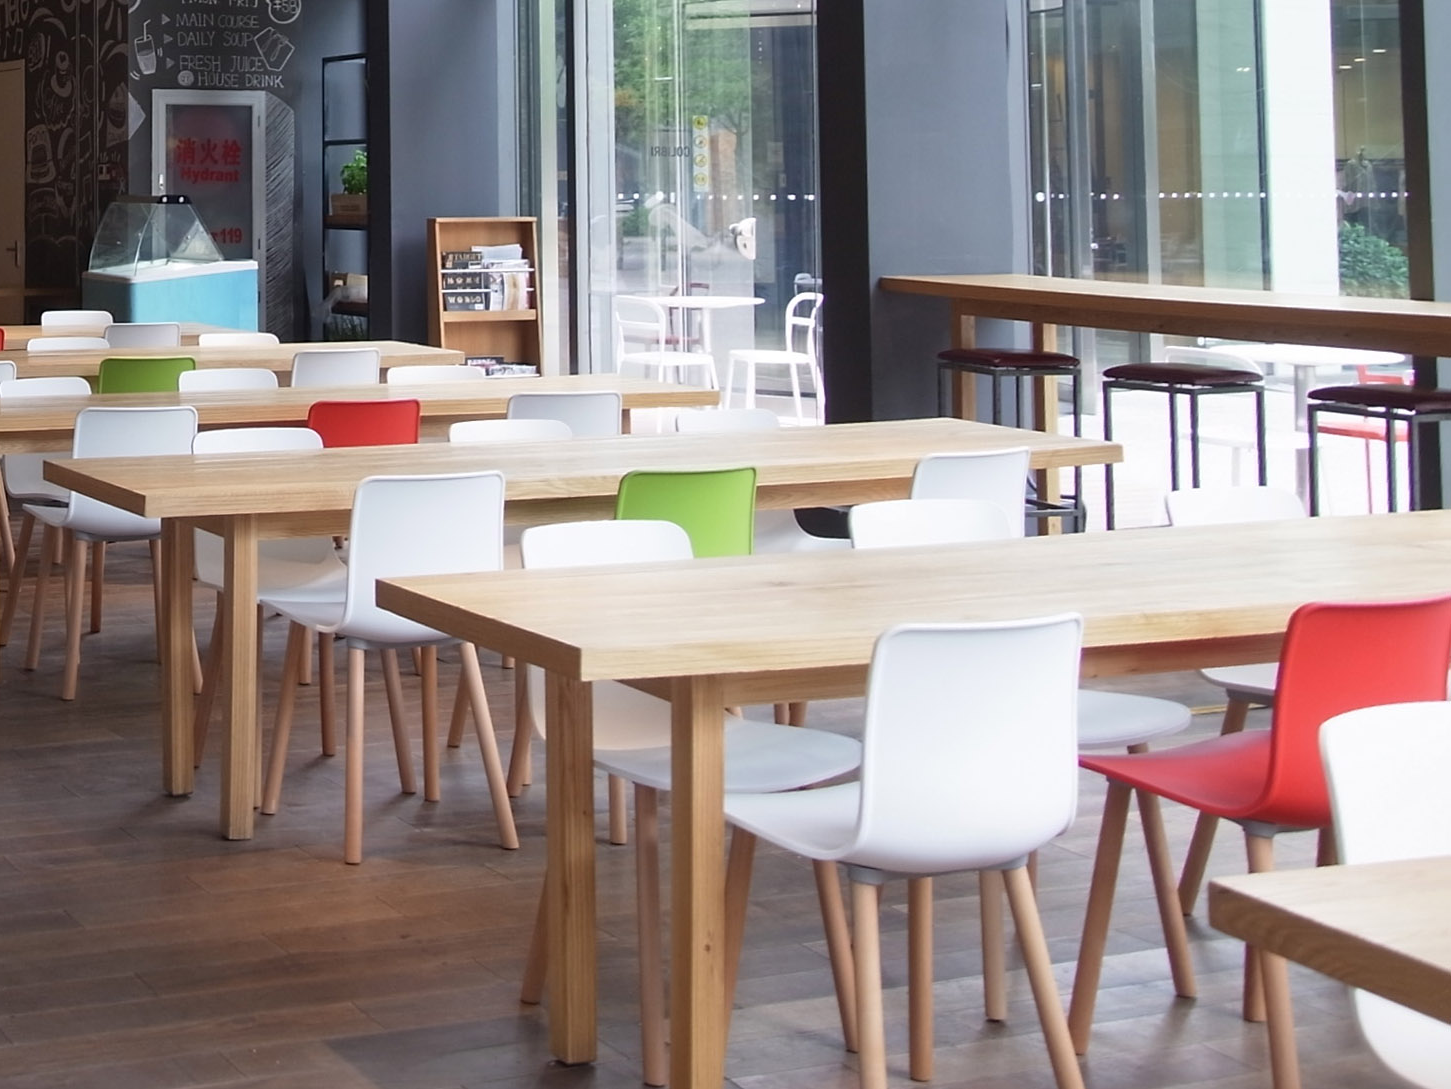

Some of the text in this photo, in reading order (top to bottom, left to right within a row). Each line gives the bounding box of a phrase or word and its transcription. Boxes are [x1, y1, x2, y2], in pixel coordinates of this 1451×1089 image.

[176, 13, 260, 29] MAIN COURSE
[177, 31, 254, 48] DAILY SOUP
[179, 56, 264, 73] FRESH JUICE
[198, 73, 239, 88] HOUSE
[245, 74, 284, 89] DRINK
[176, 137, 242, 166] 消火栓
[179, 166, 241, 185] Hydrant
